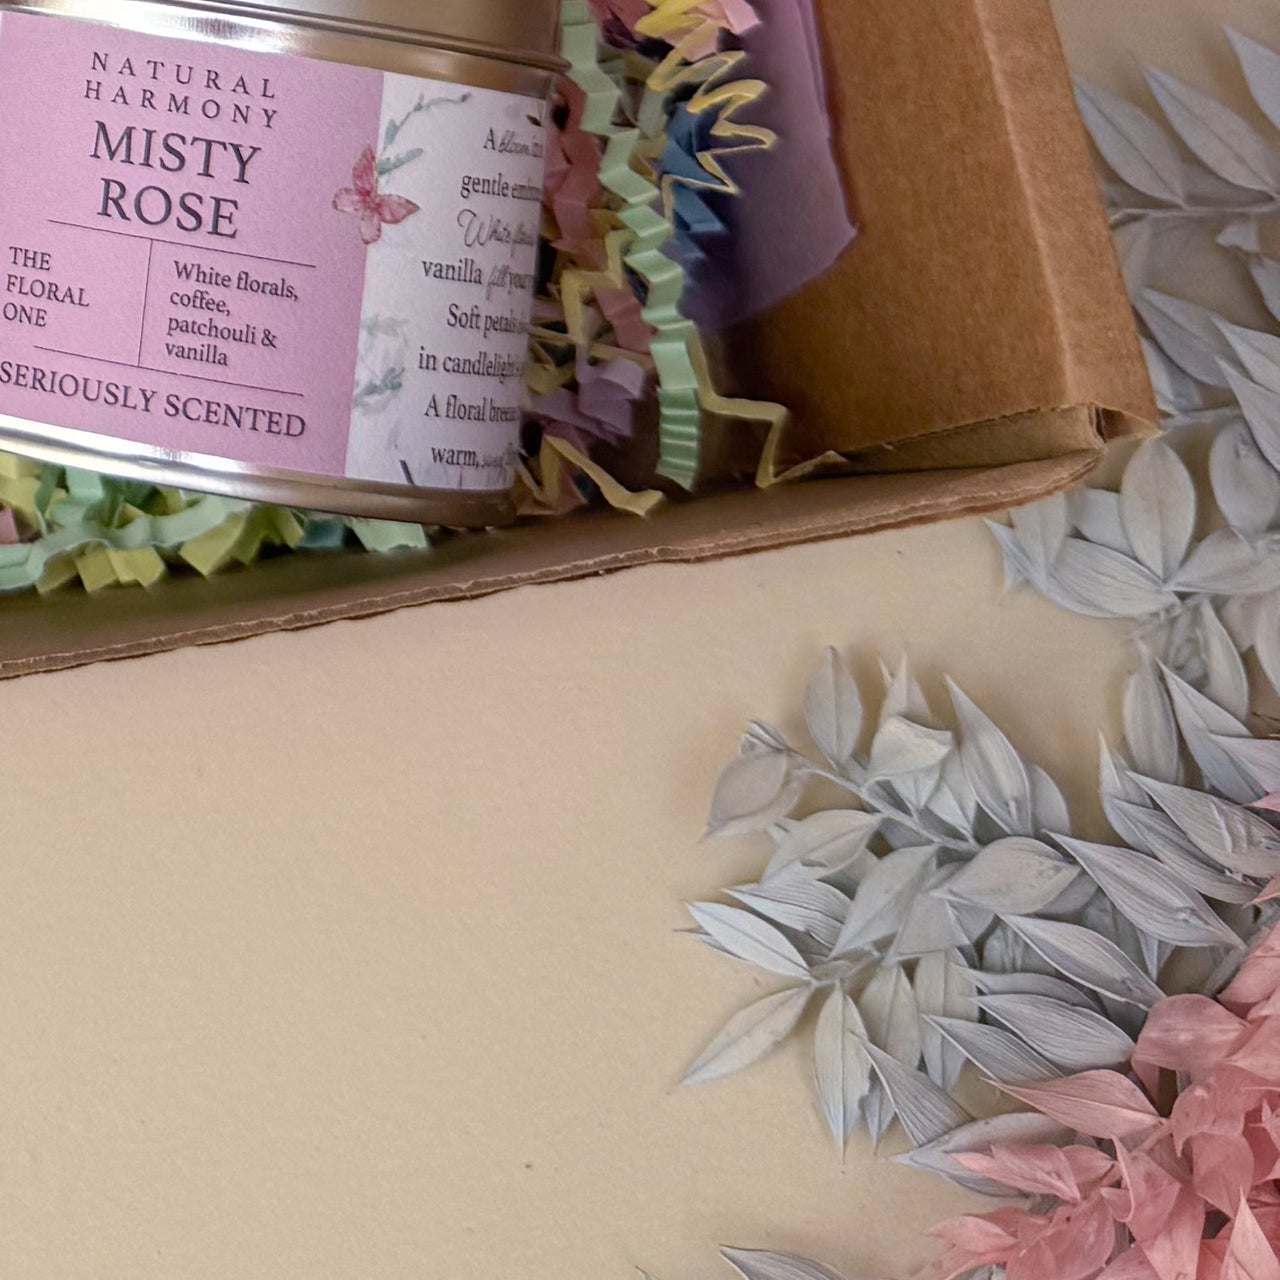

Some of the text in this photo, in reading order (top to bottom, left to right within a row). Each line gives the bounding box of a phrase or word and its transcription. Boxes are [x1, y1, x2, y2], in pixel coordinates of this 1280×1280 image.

[91, 52, 276, 98] NATURAL
[84, 80, 277, 129] HARMONY
[89, 120, 261, 184] MISTY
[483, 127, 496, 150] A
[460, 172, 509, 199] gentle
[97, 177, 239, 239] ROSE
[9, 246, 52, 271] THE
[422, 257, 482, 285] vanilla
[6, 274, 90, 307] FLORAL
[173, 260, 298, 302] White florals,
[3, 302, 47, 327] ONE
[170, 289, 231, 317] coffee,
[447, 303, 481, 329] Soft
[167, 317, 277, 349] patchouli &
[165, 342, 228, 366] vanilla
[418, 345, 437, 372] in
[164, 393, 306, 438] SCENTED
[424, 394, 439, 417] A
[445, 394, 486, 422] floral
[431, 447, 479, 470] warm,
